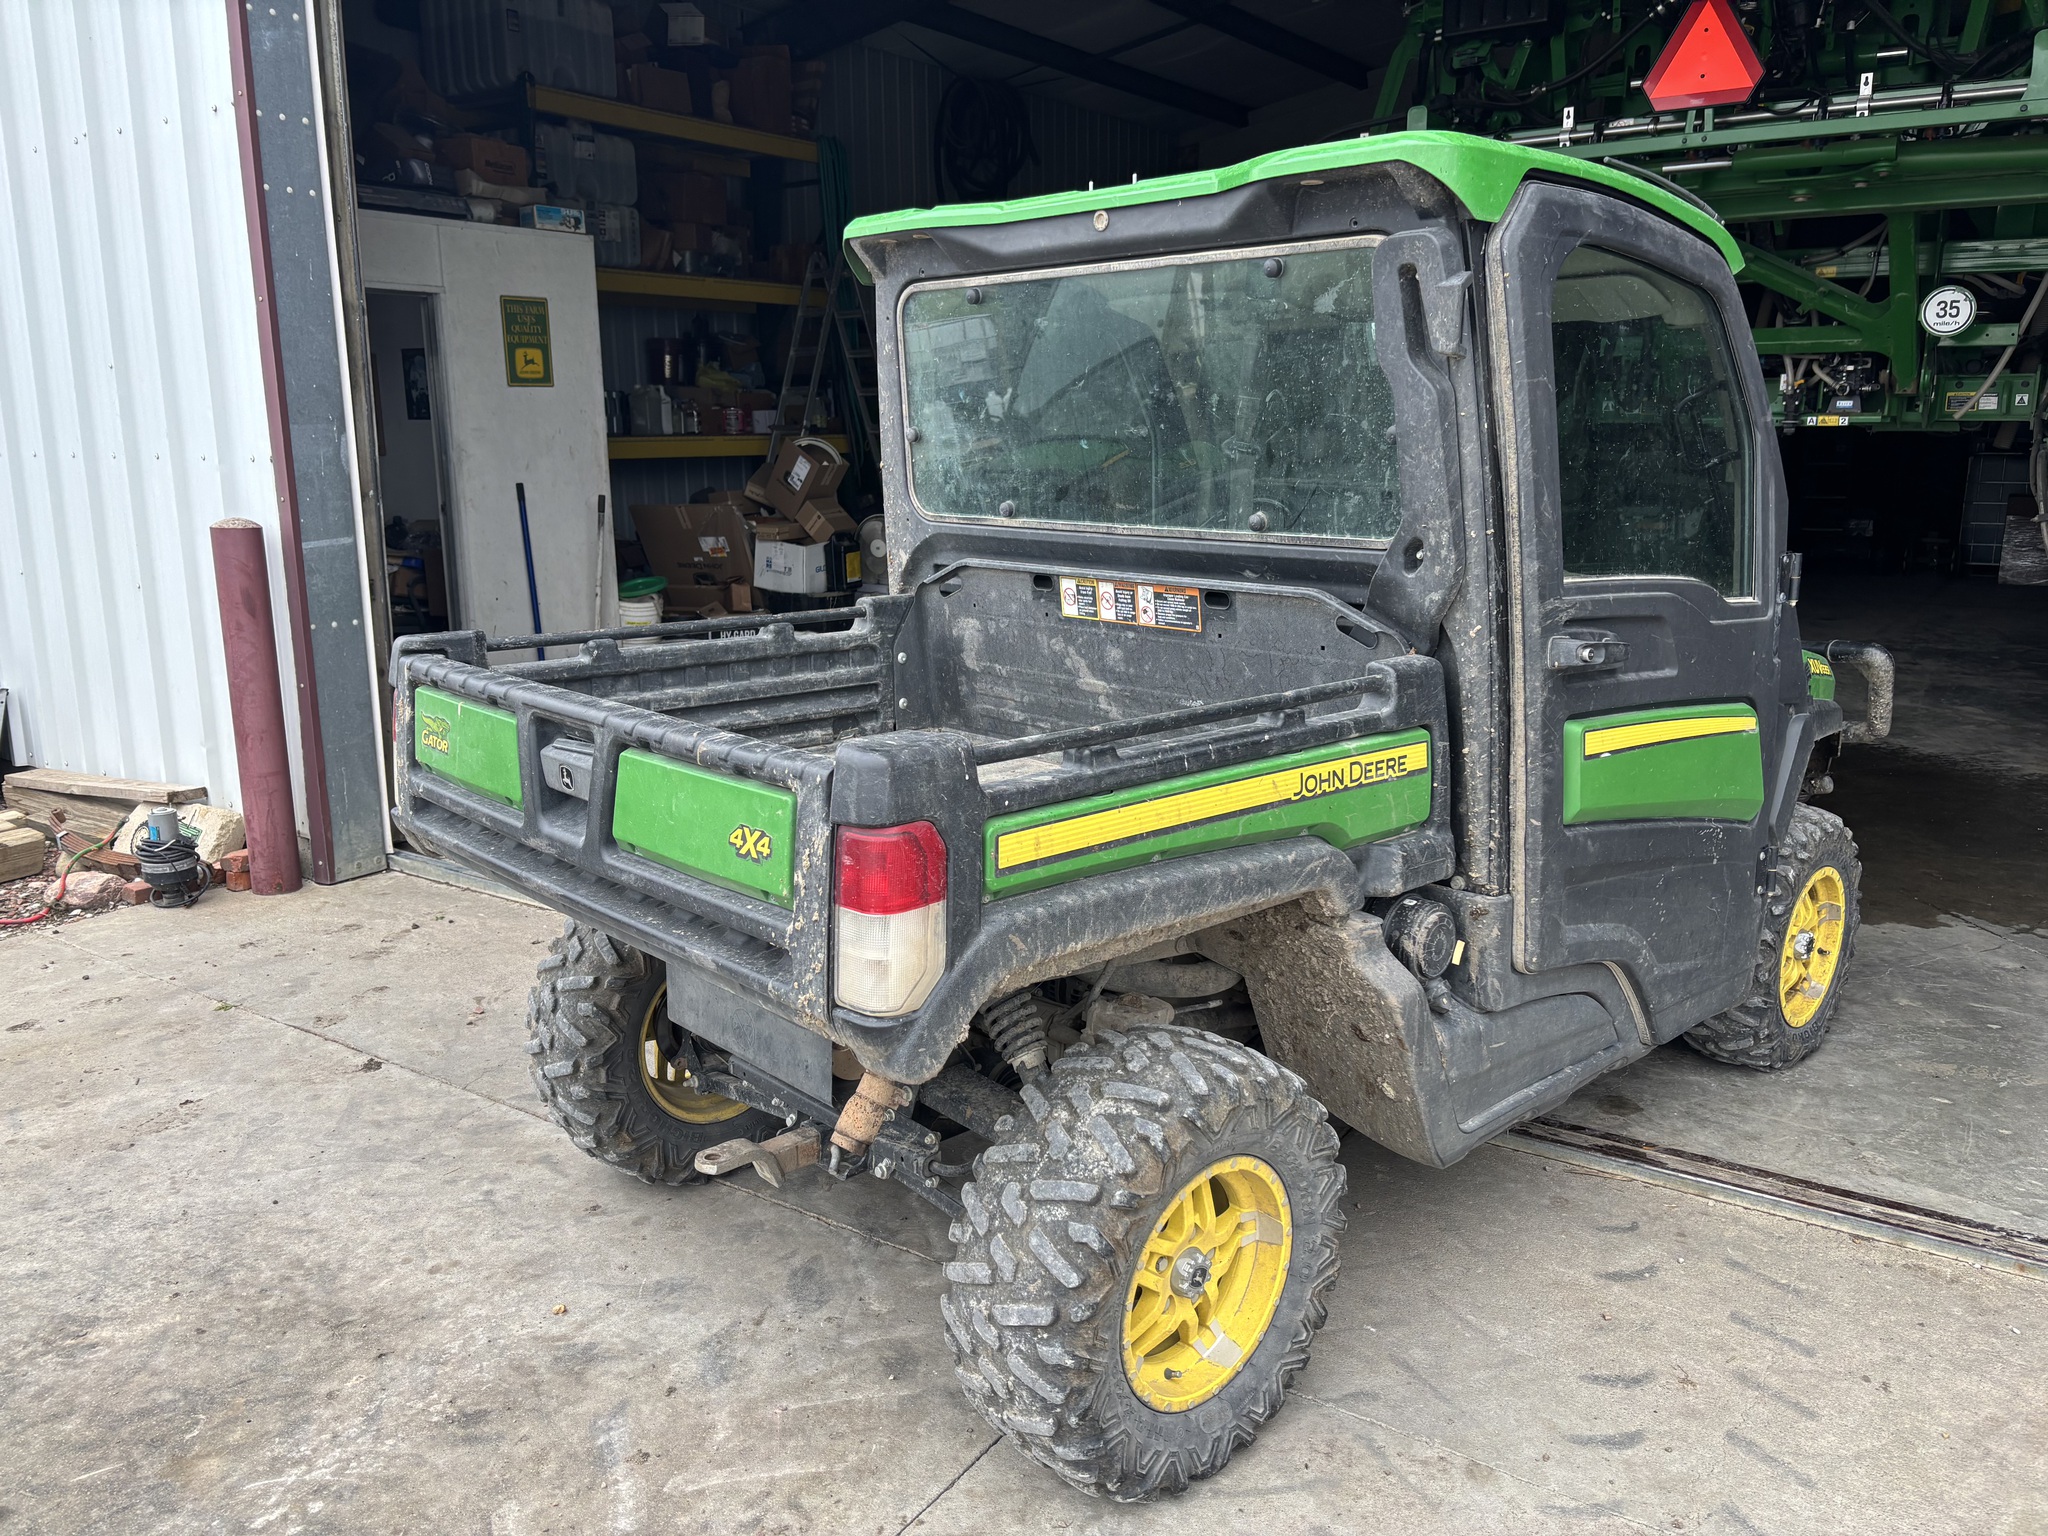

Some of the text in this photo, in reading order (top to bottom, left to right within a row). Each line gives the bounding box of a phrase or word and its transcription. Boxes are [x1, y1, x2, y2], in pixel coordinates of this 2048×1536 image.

[506, 304, 545, 315] THIS FARM
[1935, 299, 1961, 319] 35
[517, 315, 536, 325] USES
[511, 324, 542, 334] QUALITY
[507, 335, 548, 345] EQUIPMENT
[422, 729, 448, 753] GATOR
[1293, 754, 1408, 797] JOHN DEERE
